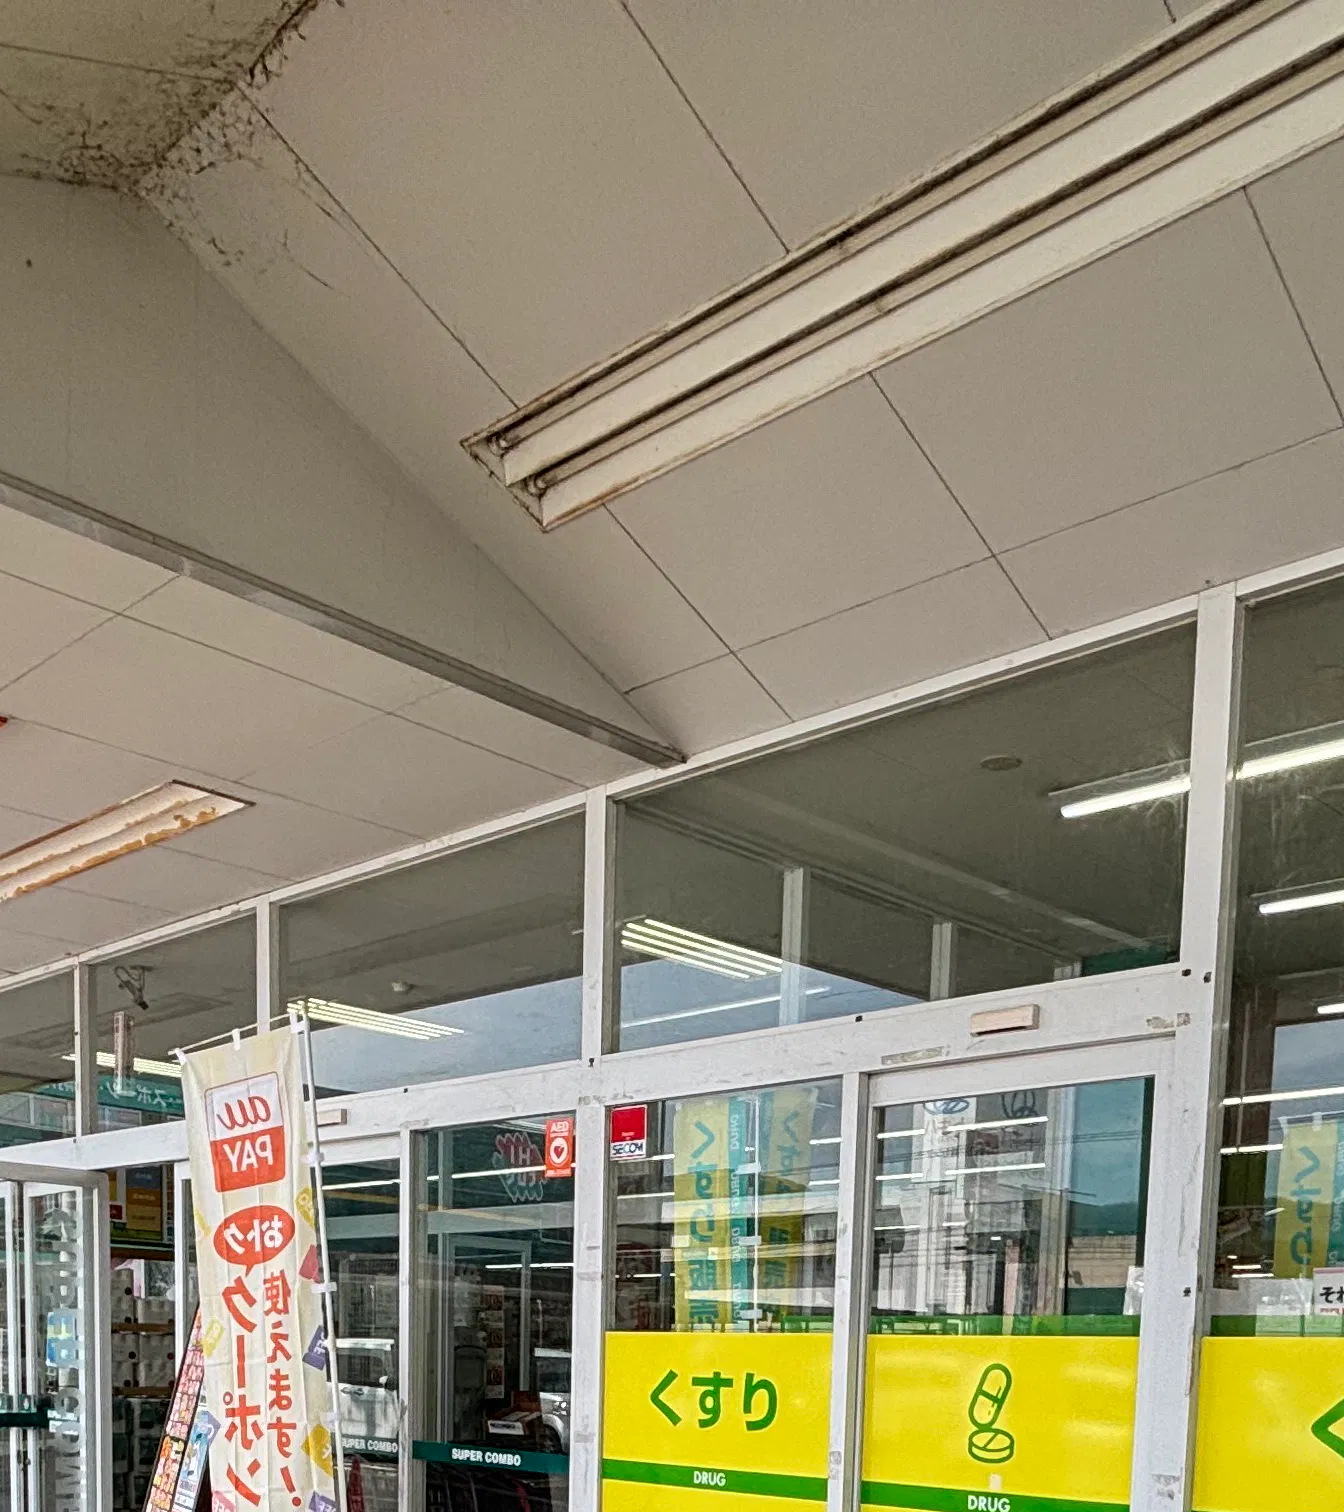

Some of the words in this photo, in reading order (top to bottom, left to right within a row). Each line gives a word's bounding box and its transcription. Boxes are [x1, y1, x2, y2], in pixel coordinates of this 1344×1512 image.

[550, 1121, 569, 1133] AED
[612, 1142, 644, 1156] SECOM
[650, 1368, 778, 1432] くすり
[367, 1439, 399, 1453] COMBO
[451, 1448, 483, 1463] SUPER
[484, 1451, 522, 1467] COMBO
[693, 1470, 727, 1488] DRUG
